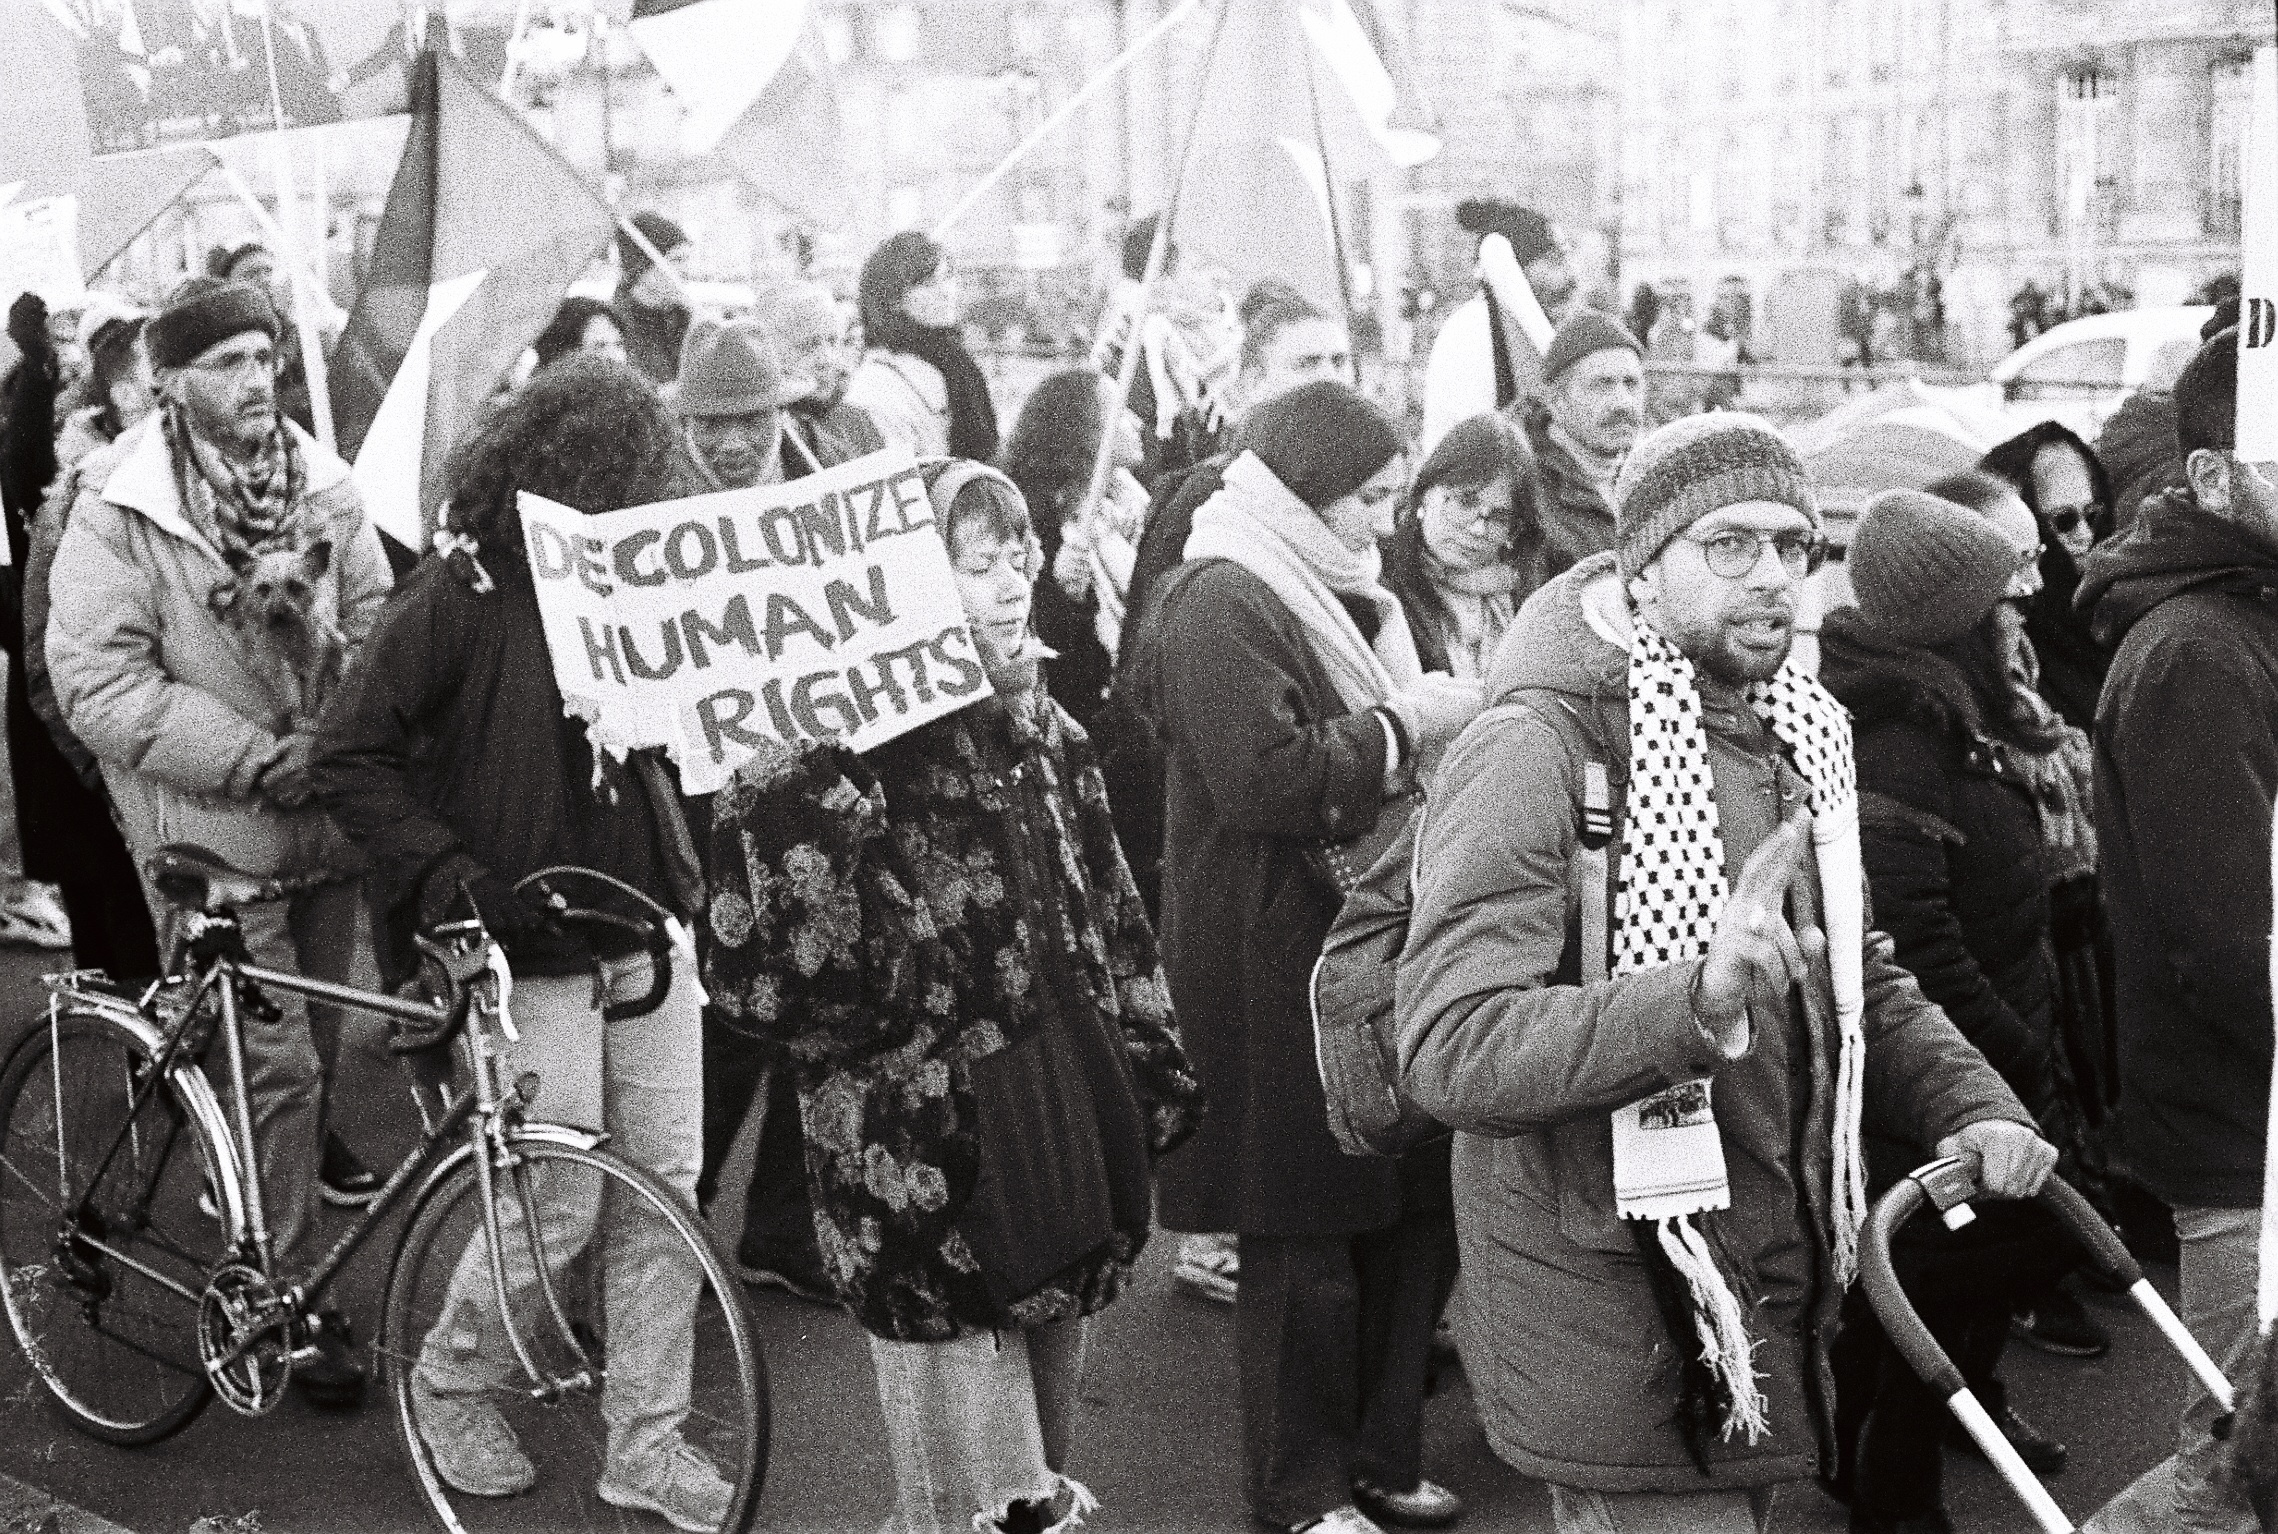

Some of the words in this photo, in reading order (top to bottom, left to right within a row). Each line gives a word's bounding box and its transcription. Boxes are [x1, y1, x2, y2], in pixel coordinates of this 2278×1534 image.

[528, 466, 935, 597] DECOLONIZE
[577, 564, 898, 686] HUMAN
[696, 626, 983, 764] RIGHTS
